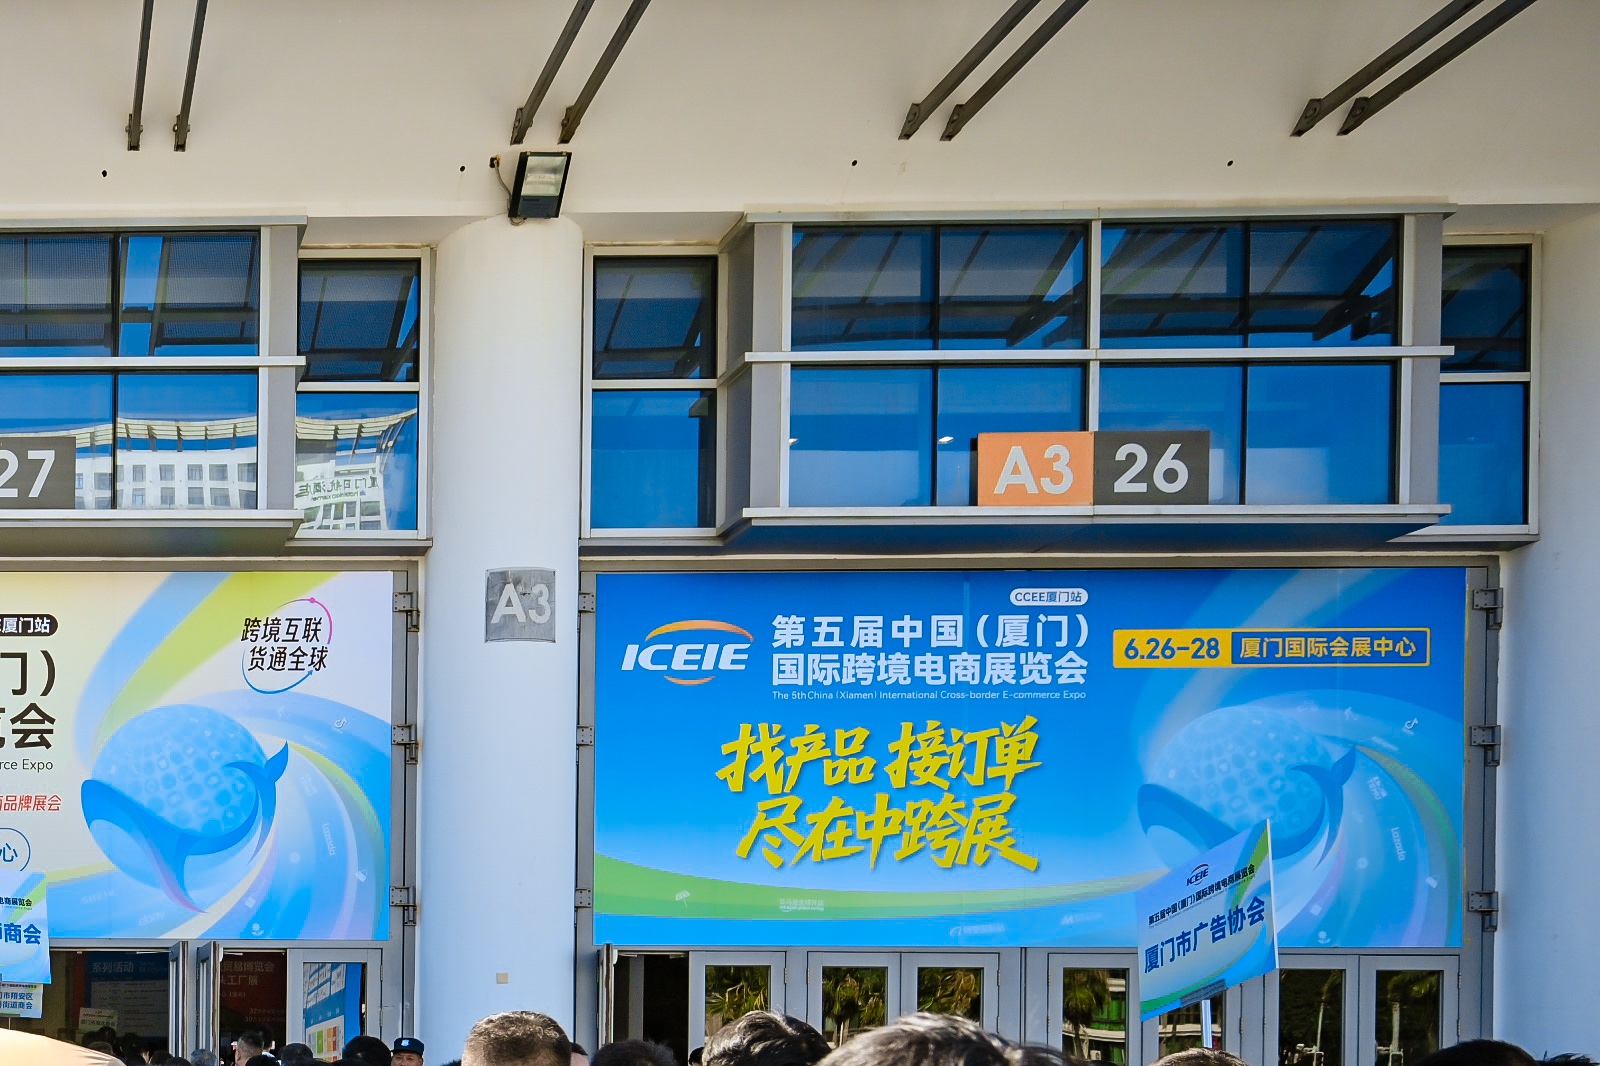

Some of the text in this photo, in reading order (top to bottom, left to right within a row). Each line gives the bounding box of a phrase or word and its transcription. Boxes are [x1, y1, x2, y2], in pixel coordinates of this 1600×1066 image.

[993, 443, 1188, 494] A3 26
[491, 583, 551, 624] A3
[1014, 591, 1082, 603] CCEE厦门站
[240, 616, 323, 643] 跨境互联
[771, 614, 1089, 648] 第五届中国（厦门）
[247, 645, 329, 671] 货通全球
[621, 643, 752, 671] ICEIE
[1124, 636, 1417, 660] 6.26-28 厦门国际会展中心
[772, 650, 1089, 686] 国际跨境电商展览会
[772, 690, 789, 701] The
[791, 690, 806, 701] 5th
[807, 690, 833, 701] China
[879, 690, 938, 701] International
[940, 690, 1000, 701] Cross-border
[1002, 690, 1061, 701] E-commerce
[1063, 691, 1086, 702] Expo
[22, 758, 54, 773] Expo
[716, 714, 1043, 794] 找产品 接订单
[735, 791, 1040, 872] 尽在中跨展
[1391, 826, 1406, 861] Lazada
[1186, 866, 1210, 887] ICEIE
[1144, 895, 1265, 974] 厦门市广告协会
[221, 961, 275, 972] 贸易博览会
